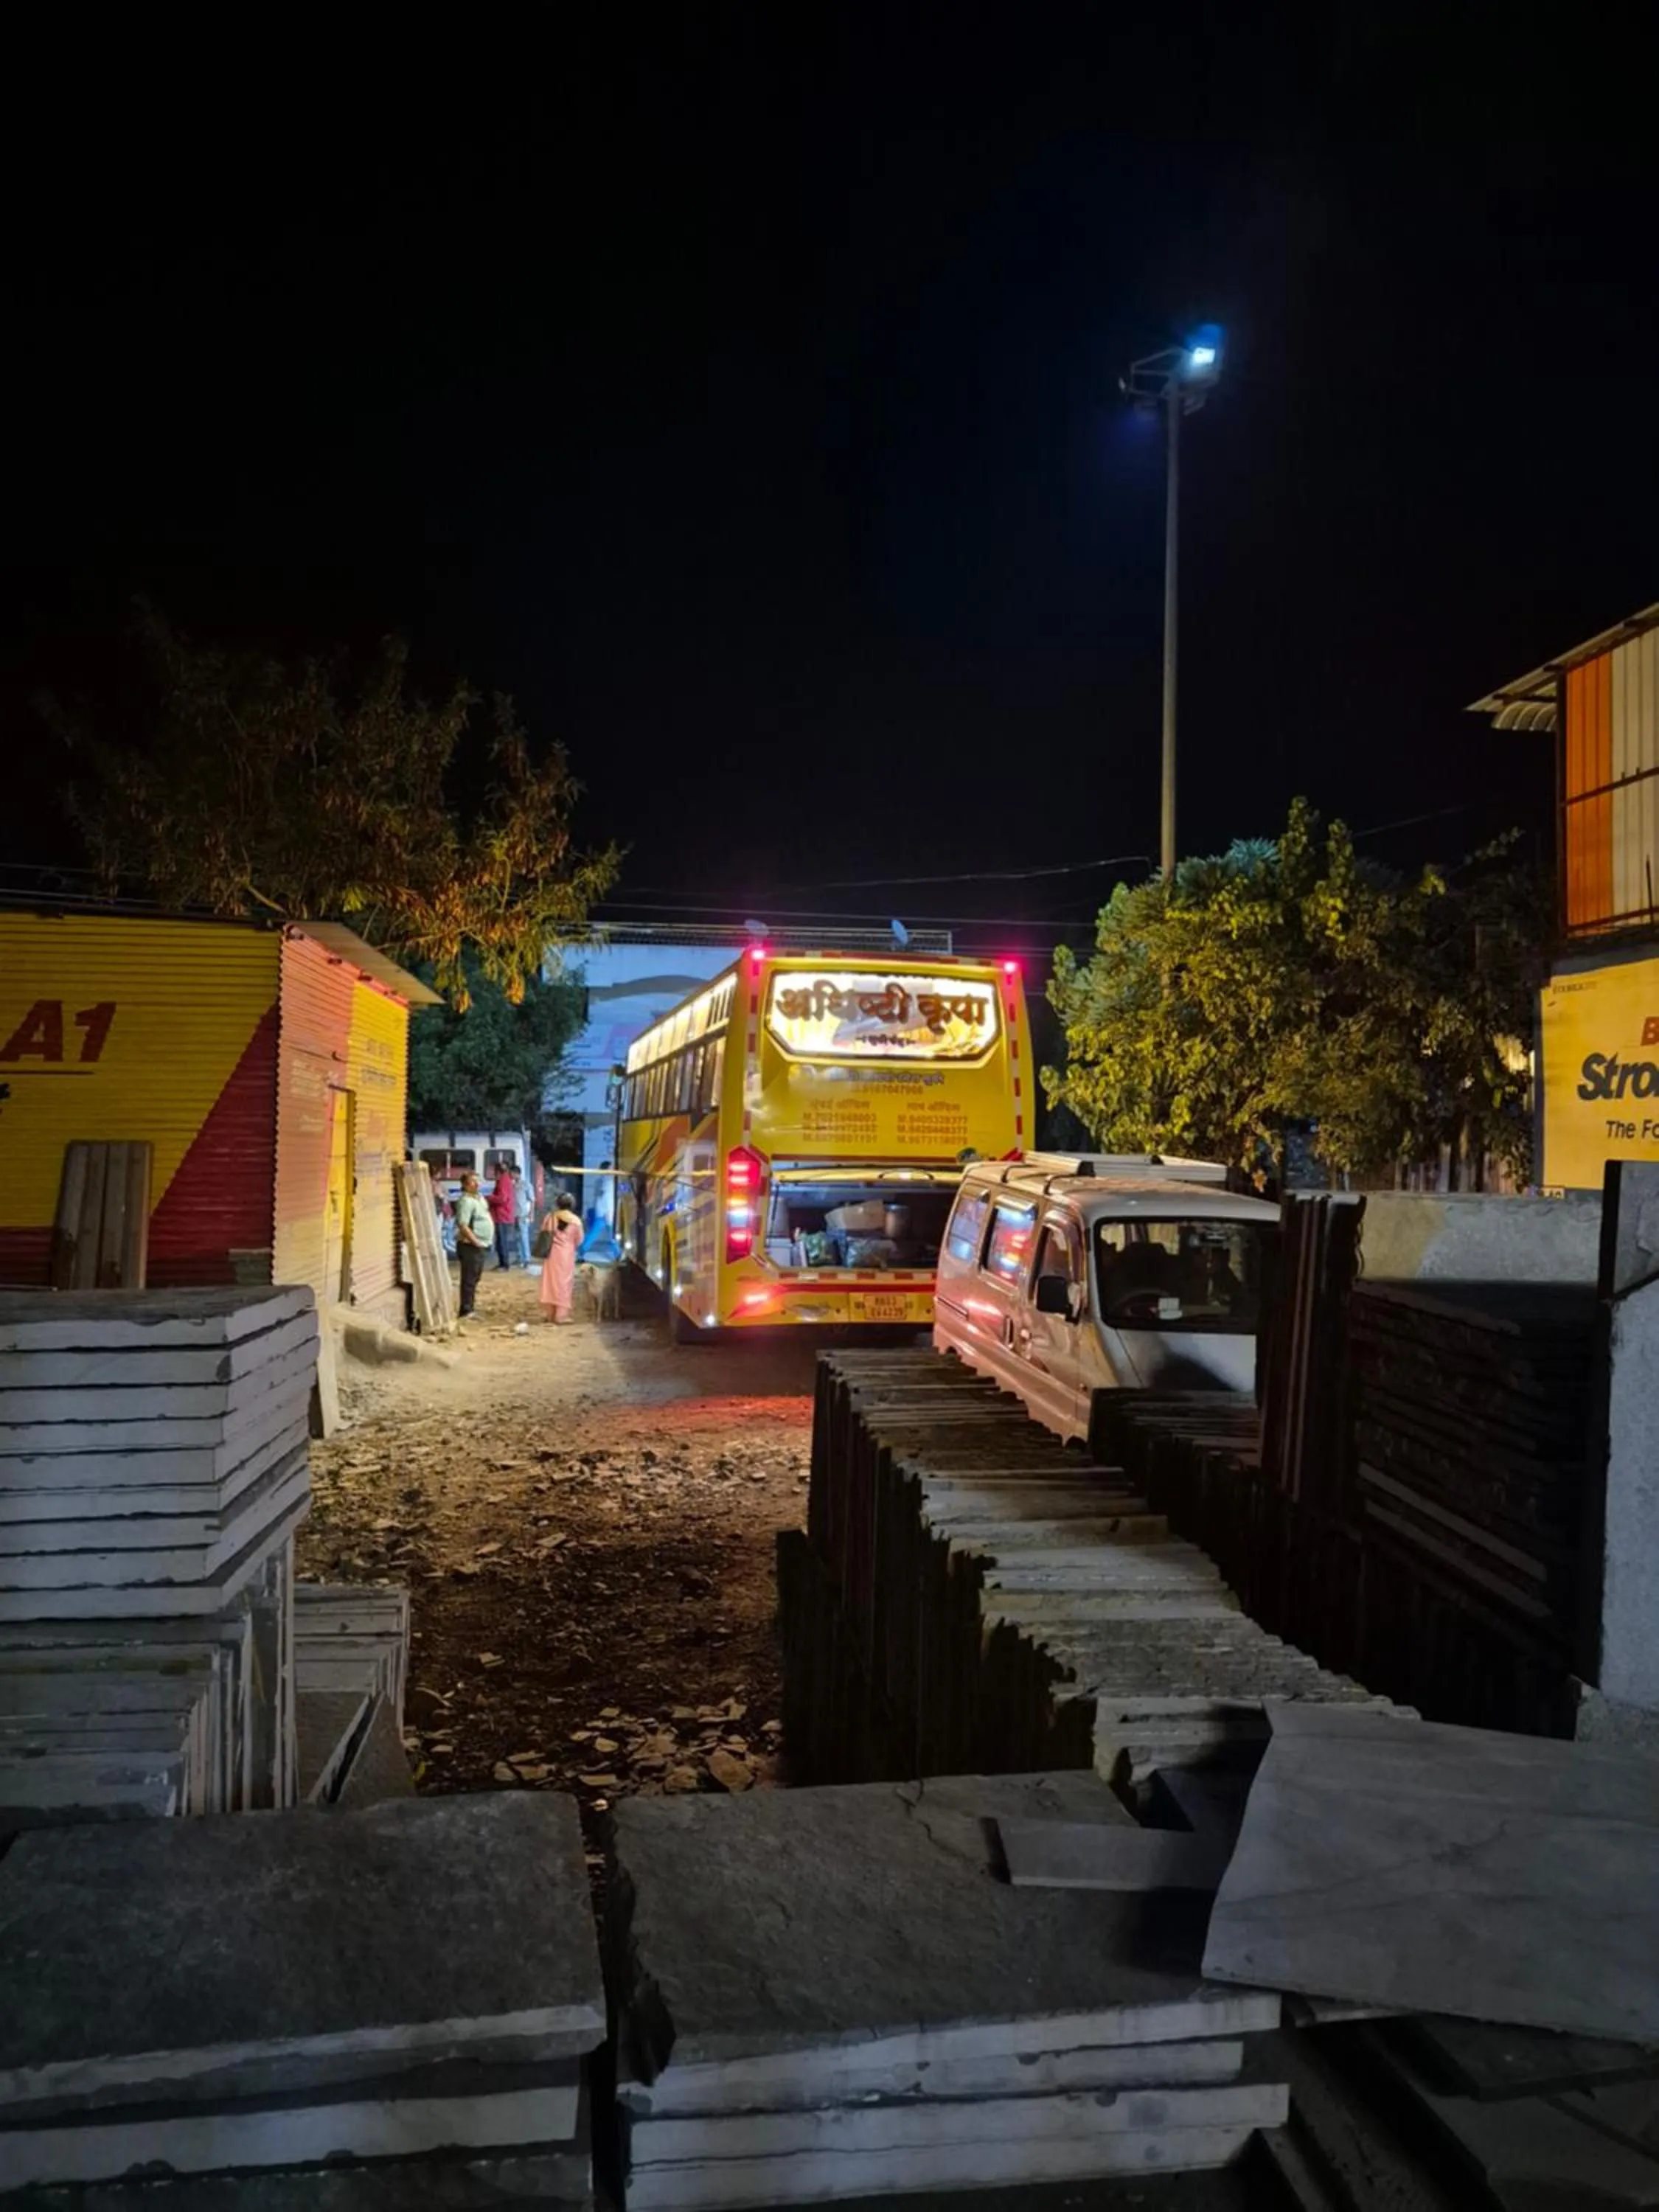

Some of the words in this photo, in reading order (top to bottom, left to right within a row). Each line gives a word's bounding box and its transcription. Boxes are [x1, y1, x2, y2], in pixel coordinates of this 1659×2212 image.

[0, 1000, 116, 1062] A1
[1577, 1051, 1659, 1101] Stro
[1606, 1120, 1635, 1139] The
